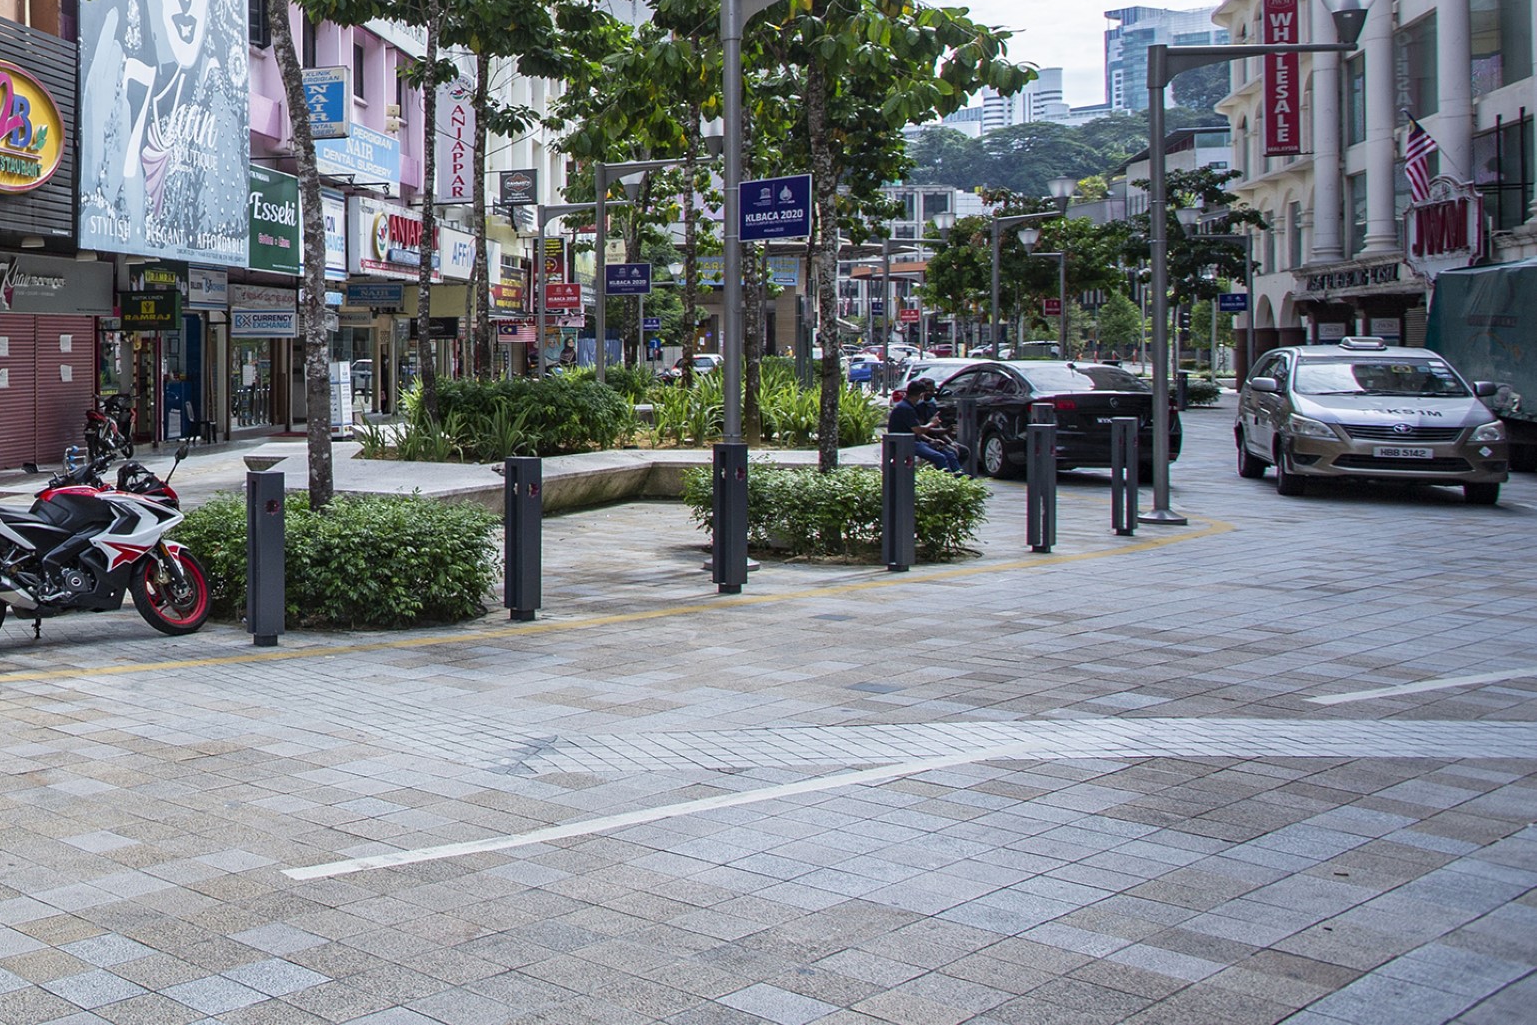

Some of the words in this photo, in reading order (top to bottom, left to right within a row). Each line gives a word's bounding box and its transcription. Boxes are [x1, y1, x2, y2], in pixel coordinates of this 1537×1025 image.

[308, 84, 329, 122] NAIR
[346, 137, 374, 161] NAIR
[353, 126, 393, 150] PERGIGIAN
[1267, 145, 1299, 153] MALAYSIA
[451, 104, 465, 197] ANJAPPAR
[323, 147, 355, 168] DENTAL
[357, 158, 392, 178] SURGERY
[249, 191, 297, 227] Esseki
[745, 211, 779, 223] KLBACA
[780, 208, 804, 220] 2020
[90, 215, 131, 241] STYLISH
[145, 223, 185, 246] ELEGANT
[196, 232, 245, 255] AFFORDABLE
[124, 313, 171, 321] RAMRAJ
[253, 314, 292, 322] CURRENCY
[253, 321, 292, 329] EXCHANGE
[1401, 449, 1427, 457] 5142
